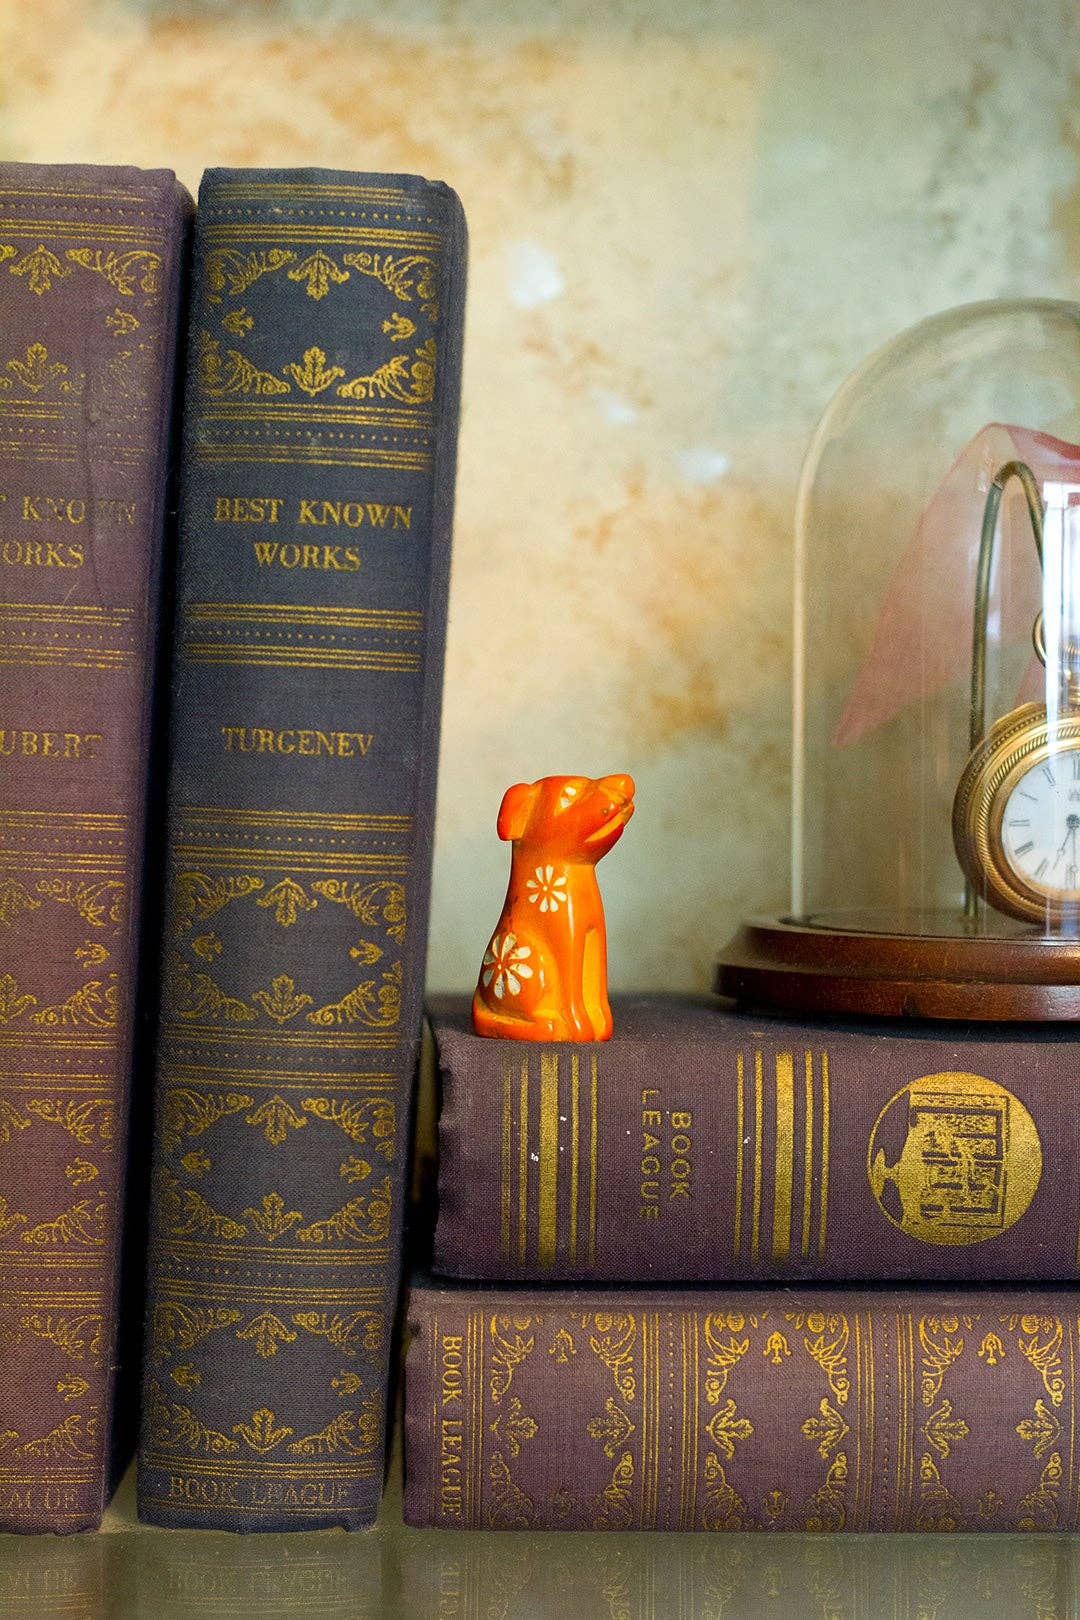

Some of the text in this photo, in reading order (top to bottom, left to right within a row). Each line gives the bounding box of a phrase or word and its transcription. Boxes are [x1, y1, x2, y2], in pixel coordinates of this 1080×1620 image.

[22, 495, 137, 525] KNON
[213, 497, 413, 529] BEST KNOWN
[0, 540, 84, 569] ORKS
[253, 541, 362, 572] WORKS
[221, 726, 375, 757] TURGENEV
[640, 1088, 662, 1219] LEAGUE
[669, 1111, 693, 1202] BOOK
[440, 1334, 464, 1517] BOOK LEAGUE
[169, 1475, 352, 1506] BOOK LEAGUE
